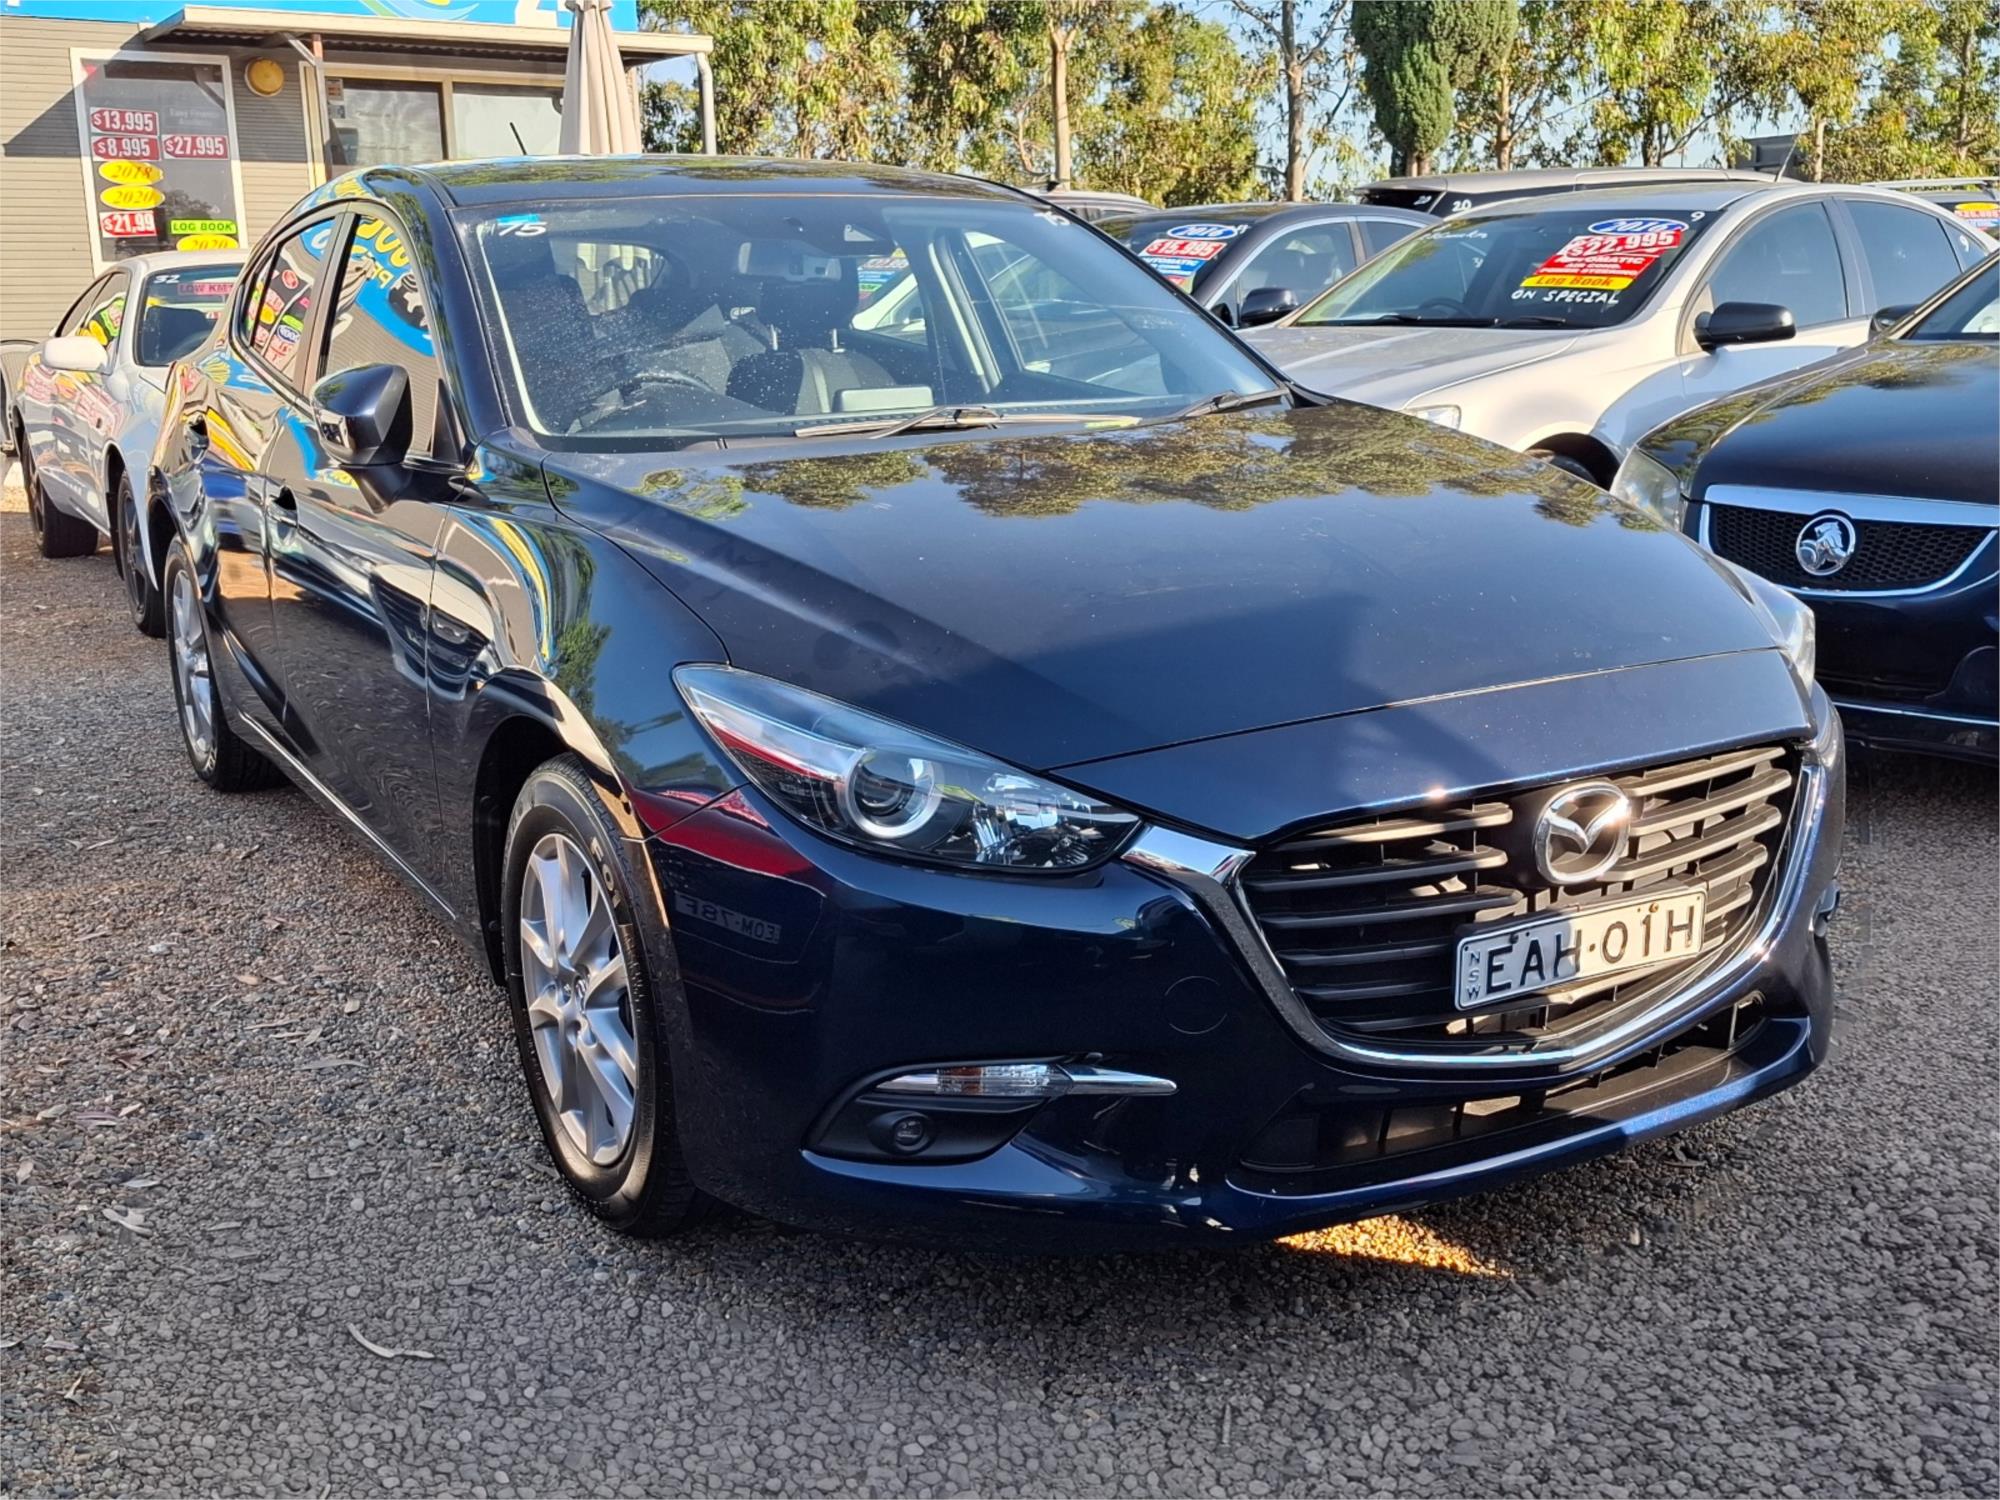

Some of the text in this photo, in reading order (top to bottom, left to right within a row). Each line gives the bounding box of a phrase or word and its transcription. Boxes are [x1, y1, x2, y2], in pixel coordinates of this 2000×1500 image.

[93, 110, 153, 132] $13,995
[98, 138, 151, 157] $8,995
[165, 136, 225, 156] $27,995
[111, 165, 153, 179] 2018
[112, 191, 154, 204] 2020
[1451, 199, 1472, 212] 20
[1690, 211, 1706, 222] 9
[173, 222, 234, 232] LOG BOOK
[498, 221, 548, 237] 75
[1611, 220, 1670, 232] 2016
[1570, 230, 1675, 257] $22,995
[180, 284, 206, 292] LOW
[1536, 276, 1613, 287] Log Book
[1511, 290, 1620, 304] ON SPECIAL
[1466, 951, 1481, 1000] NSW
